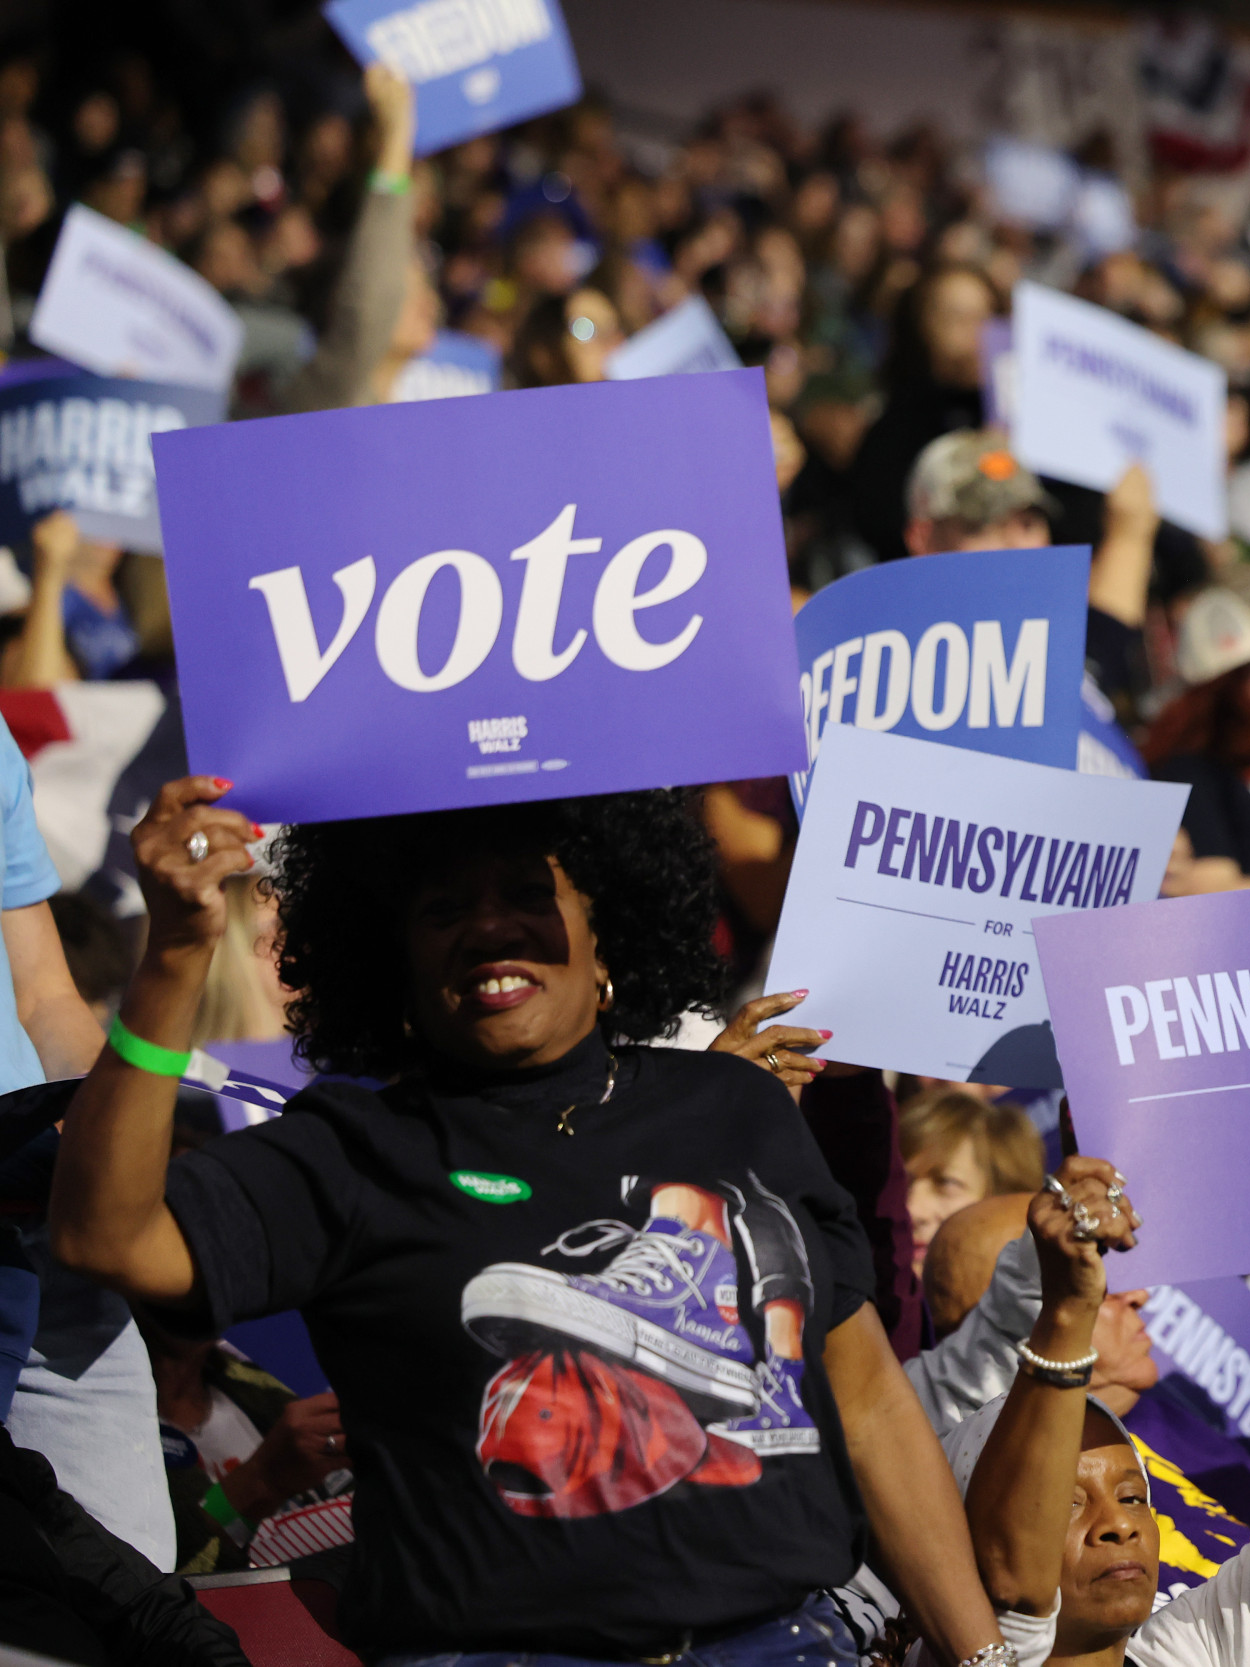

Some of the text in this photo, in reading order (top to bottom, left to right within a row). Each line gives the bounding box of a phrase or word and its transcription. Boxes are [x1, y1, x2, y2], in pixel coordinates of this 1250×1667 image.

[249, 503, 708, 703] vote
[467, 715, 529, 744] HARRIS
[794, 618, 1049, 806] REEDOM
[478, 737, 521, 755] WALZ
[844, 800, 1141, 909] PENNSYLVANIA
[983, 919, 1014, 937] FOR
[937, 951, 1030, 998] HARRIS
[948, 994, 1007, 1020] WALZ
[673, 1303, 742, 1352] Kamala
